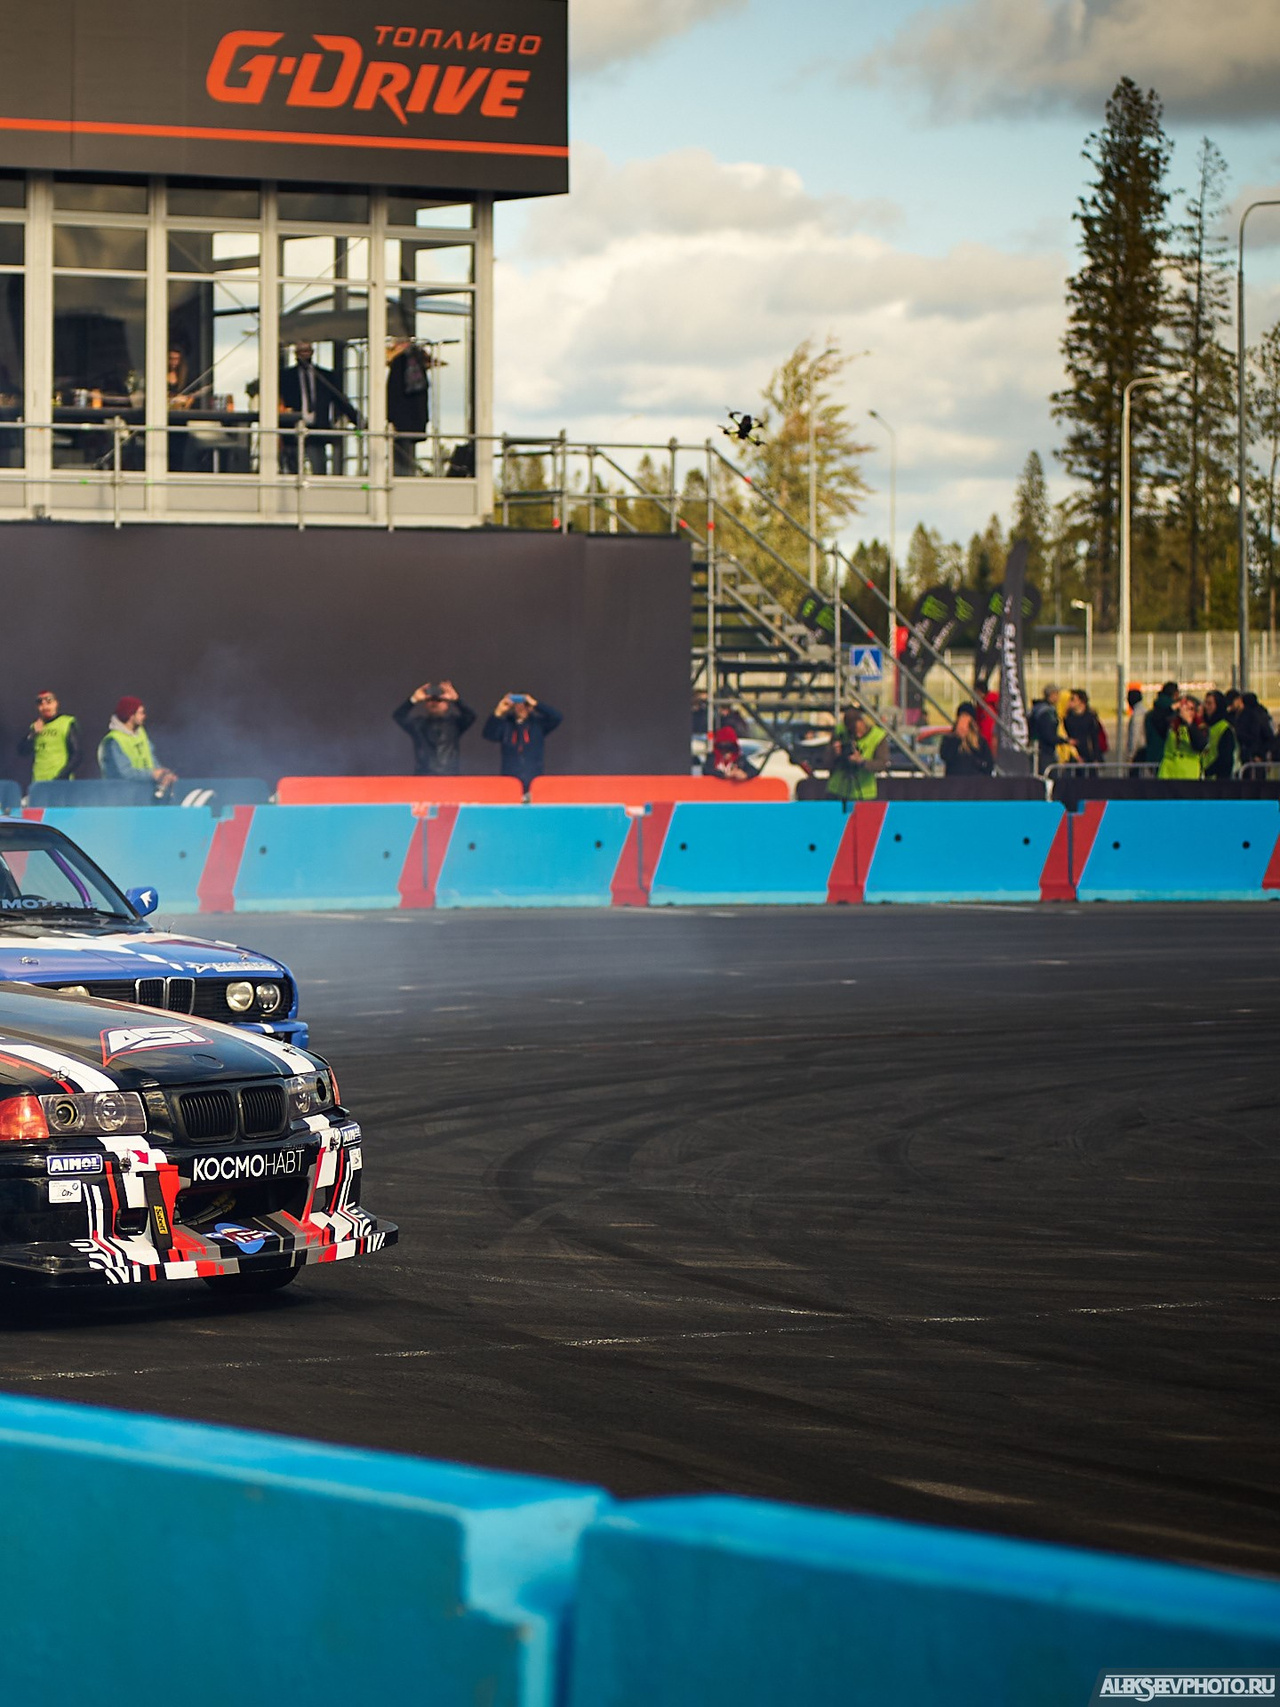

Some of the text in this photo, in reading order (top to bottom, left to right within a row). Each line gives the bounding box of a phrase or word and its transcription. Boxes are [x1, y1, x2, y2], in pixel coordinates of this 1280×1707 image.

[374, 25, 543, 56] ТОПЛИВО
[50, 1157, 101, 1172] AIMOL
[193, 1150, 305, 1182] КОСМОНАВТ
